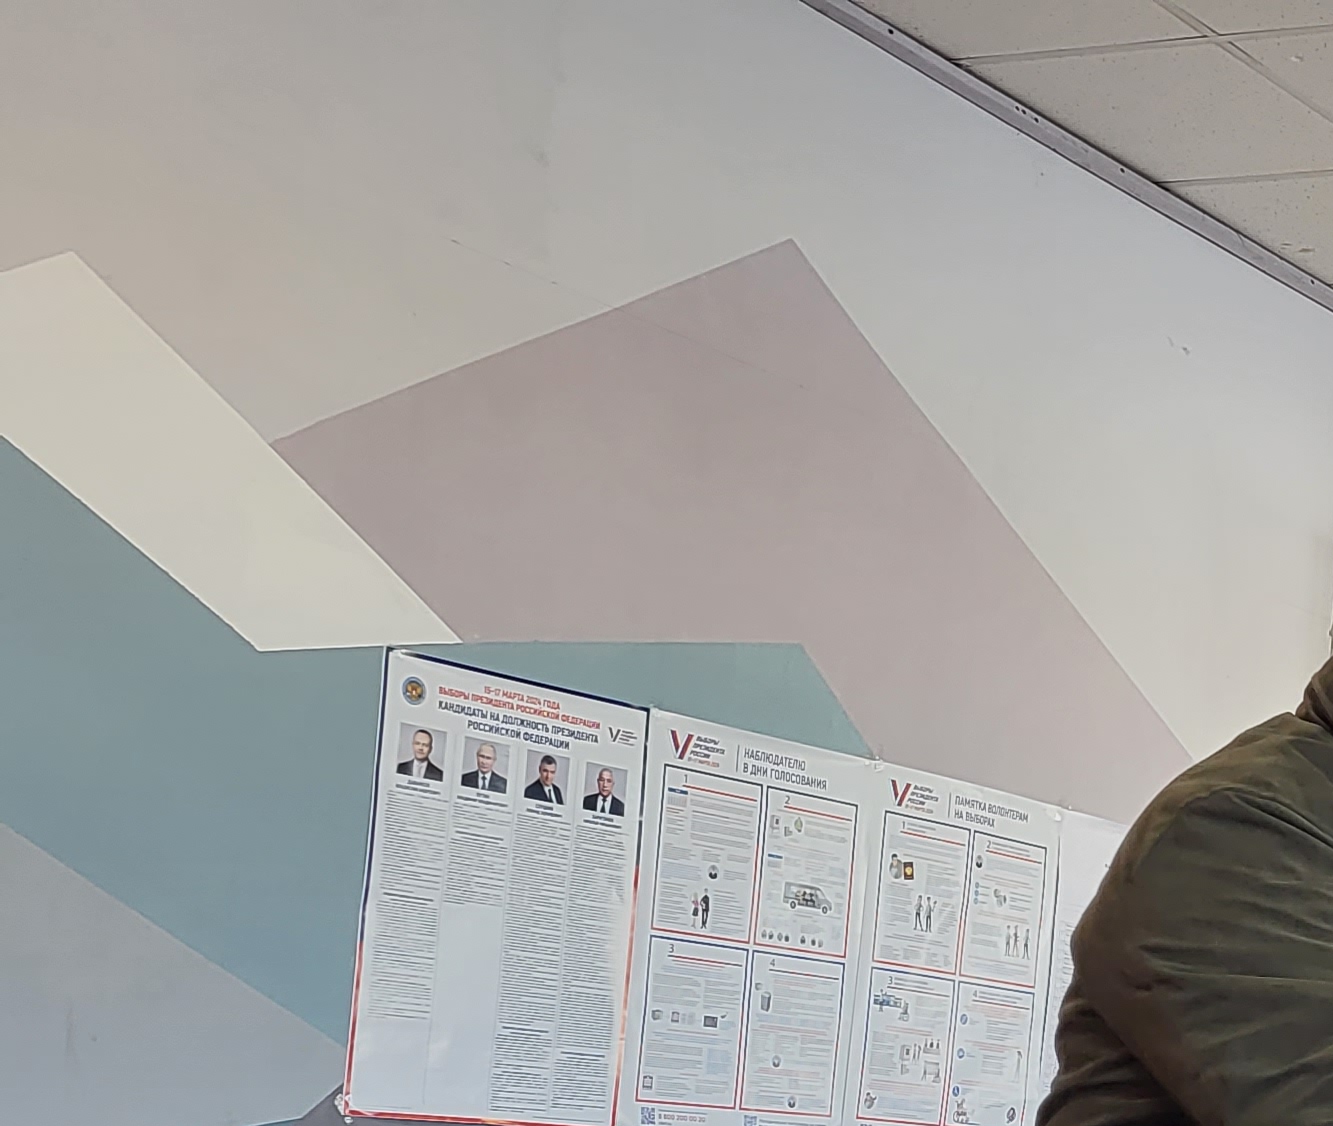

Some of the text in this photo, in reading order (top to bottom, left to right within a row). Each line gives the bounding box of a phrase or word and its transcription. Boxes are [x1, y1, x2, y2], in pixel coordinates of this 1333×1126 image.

[439, 687, 600, 729] ВЫБОРЫ ПРЕЗИДЕНТА РОССИЙСКОЙ ФЕДЕРАЦИИ
[502, 690, 524, 702] МАРТА
[526, 696, 541, 706] 2024
[543, 700, 560, 710] ГОДА
[438, 701, 598, 743] КАНДИДАТЫ НА ДОЛЖНОСТЬ ПРЕЗИДЕНТА
[468, 720, 570, 750] РОССИЙСКОЙ ФЕДЕРАЦИИ
[744, 748, 805, 771] НАБЛЮДАТЕЛЮ
[743, 763, 827, 790] В ДНИ ГОЛОСОВАНИЯ
[954, 809, 995, 828] НА ВЫБОРАХ
[955, 796, 1028, 823] ПАМЯТКА ВОЛОНТЕРАМ
